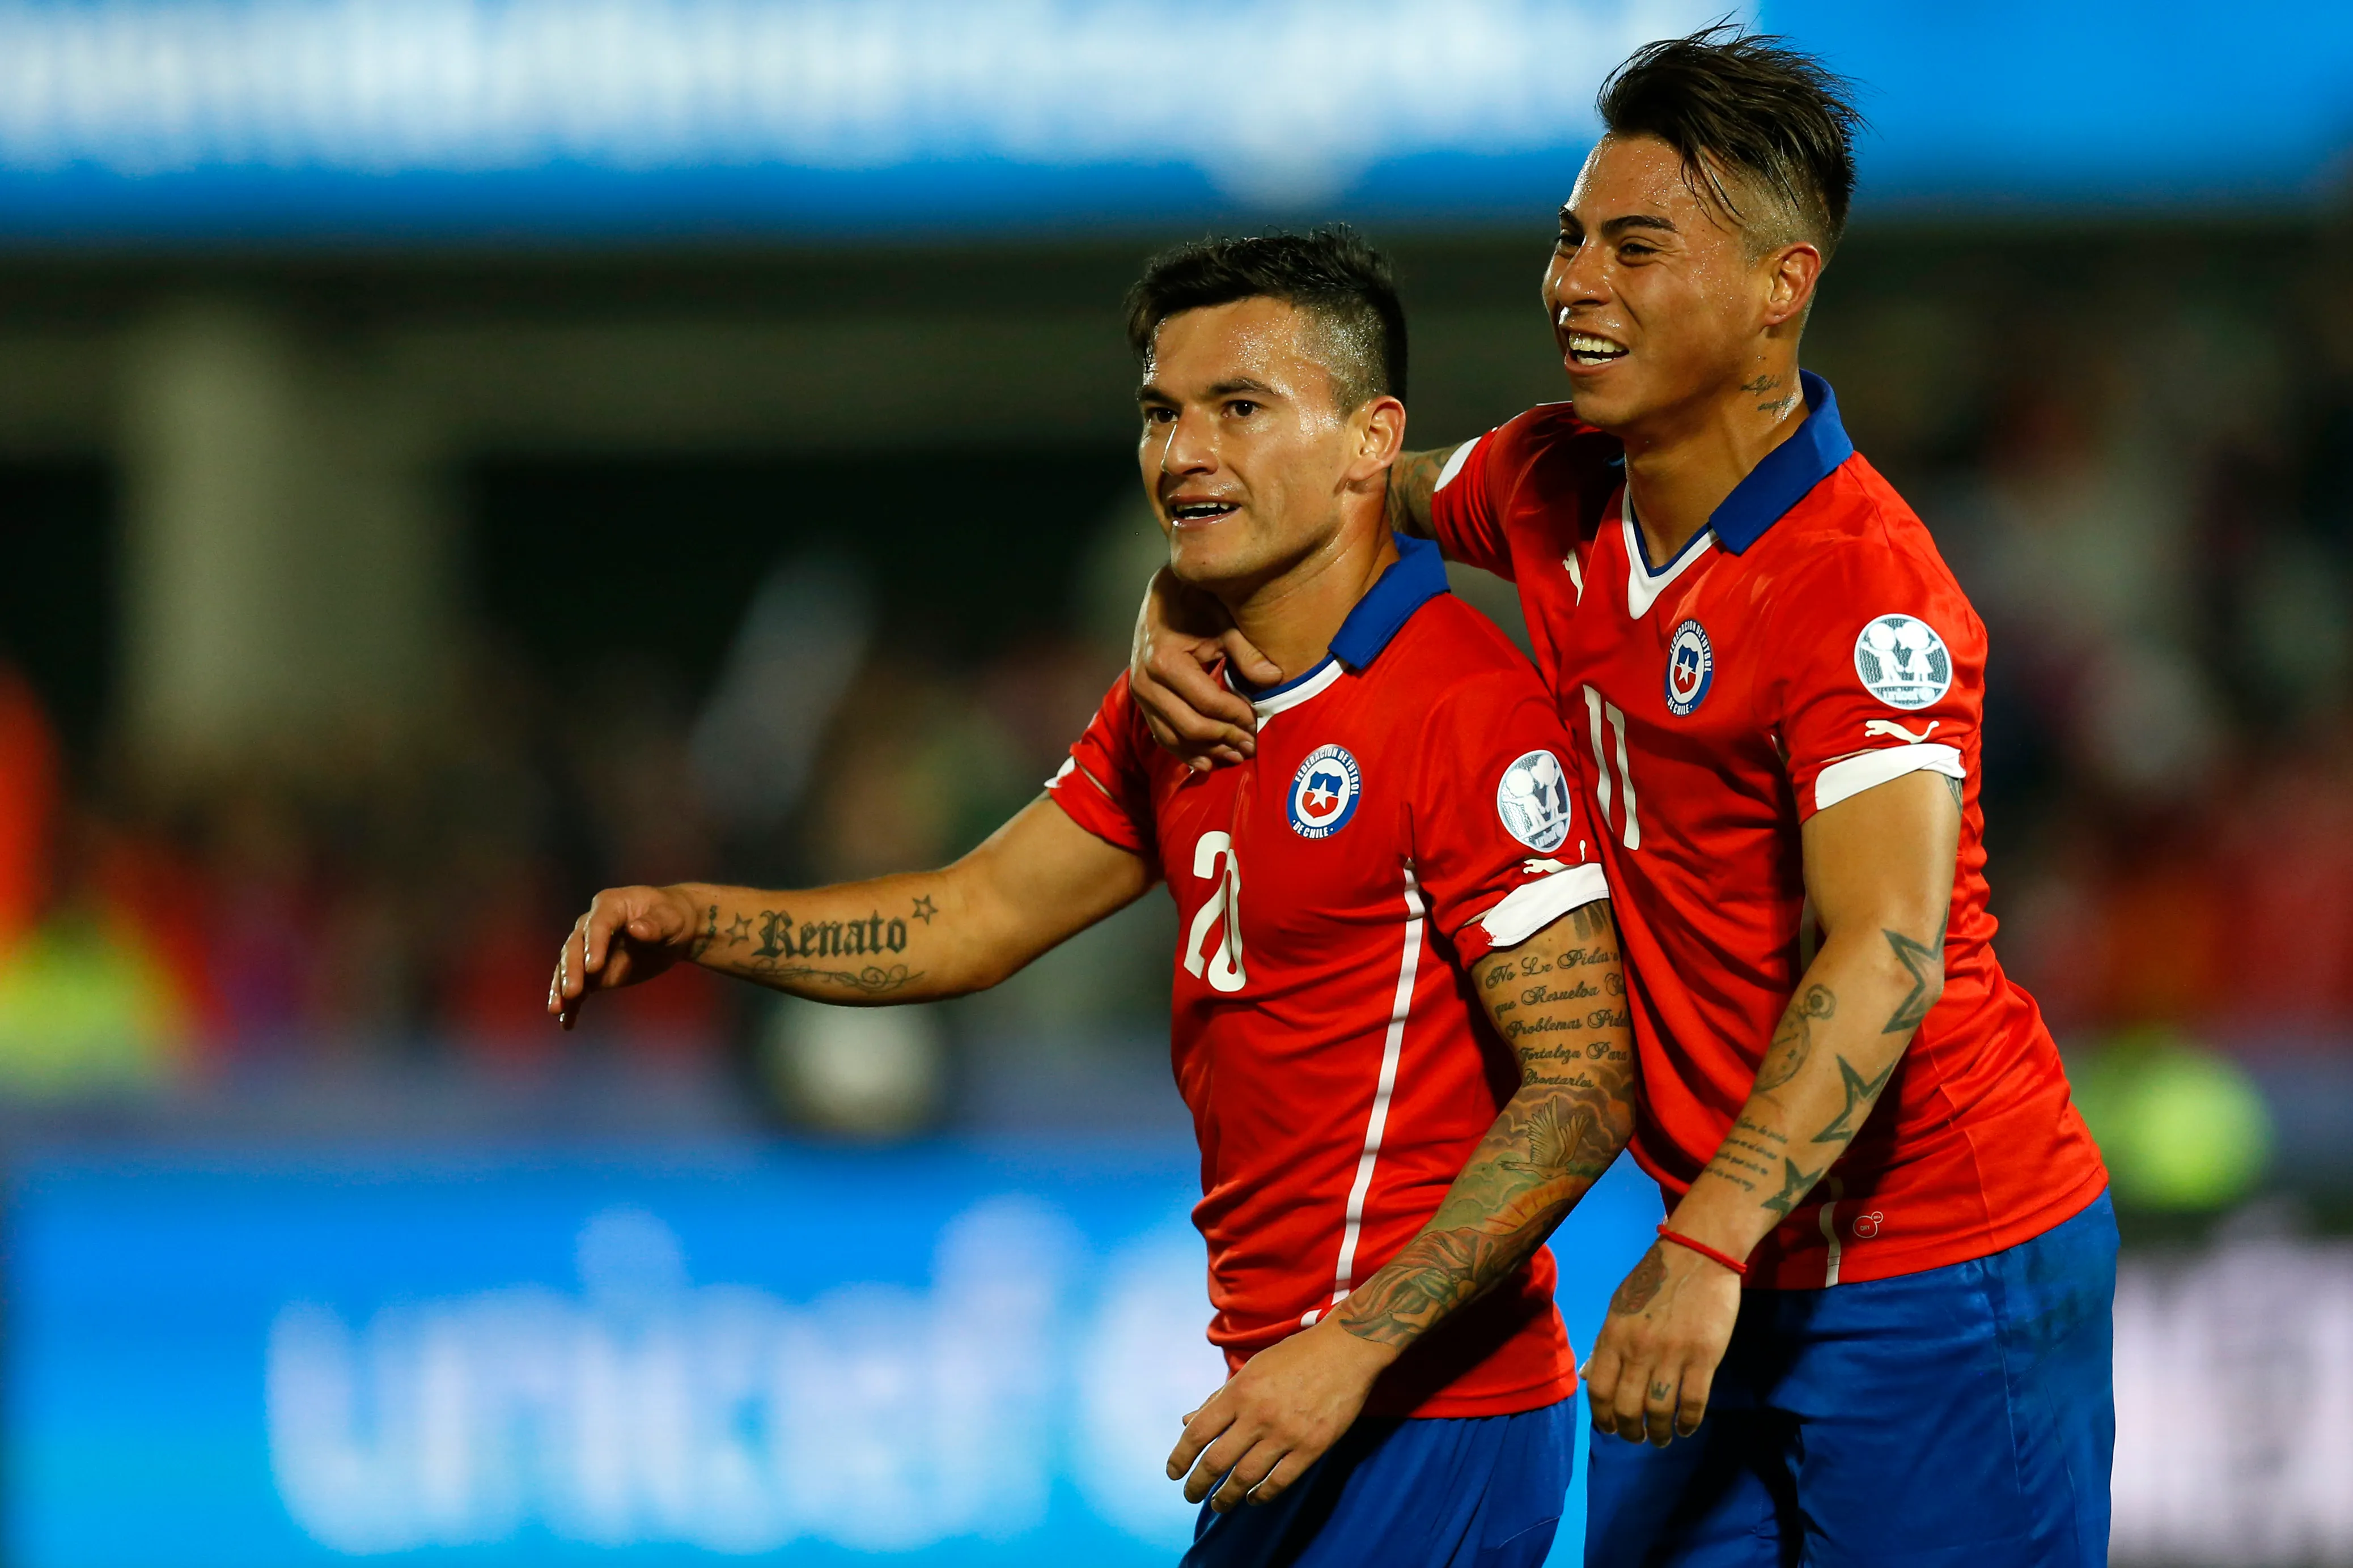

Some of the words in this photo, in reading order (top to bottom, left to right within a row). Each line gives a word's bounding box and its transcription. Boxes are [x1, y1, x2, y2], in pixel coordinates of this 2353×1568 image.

[1696, 624, 1703, 638] DE
[1701, 634, 1712, 673] FUTBOL
[1668, 698, 1675, 710] DE
[1673, 703, 1690, 716] CHILE
[1295, 747, 1338, 783] FEDERACION
[1337, 750, 1349, 763] DE
[1345, 760, 1360, 796] FUTBOL
[1583, 684, 1640, 851] 11
[1292, 821, 1304, 834] DE
[1303, 827, 1329, 839] CHILE
[1184, 830, 1247, 992] 20
[751, 909, 907, 959] Renato
[1485, 963, 1516, 989] No
[1521, 957, 1554, 977] Le
[1494, 1001, 1517, 1021] que
[1506, 1015, 1583, 1040] Problemas
